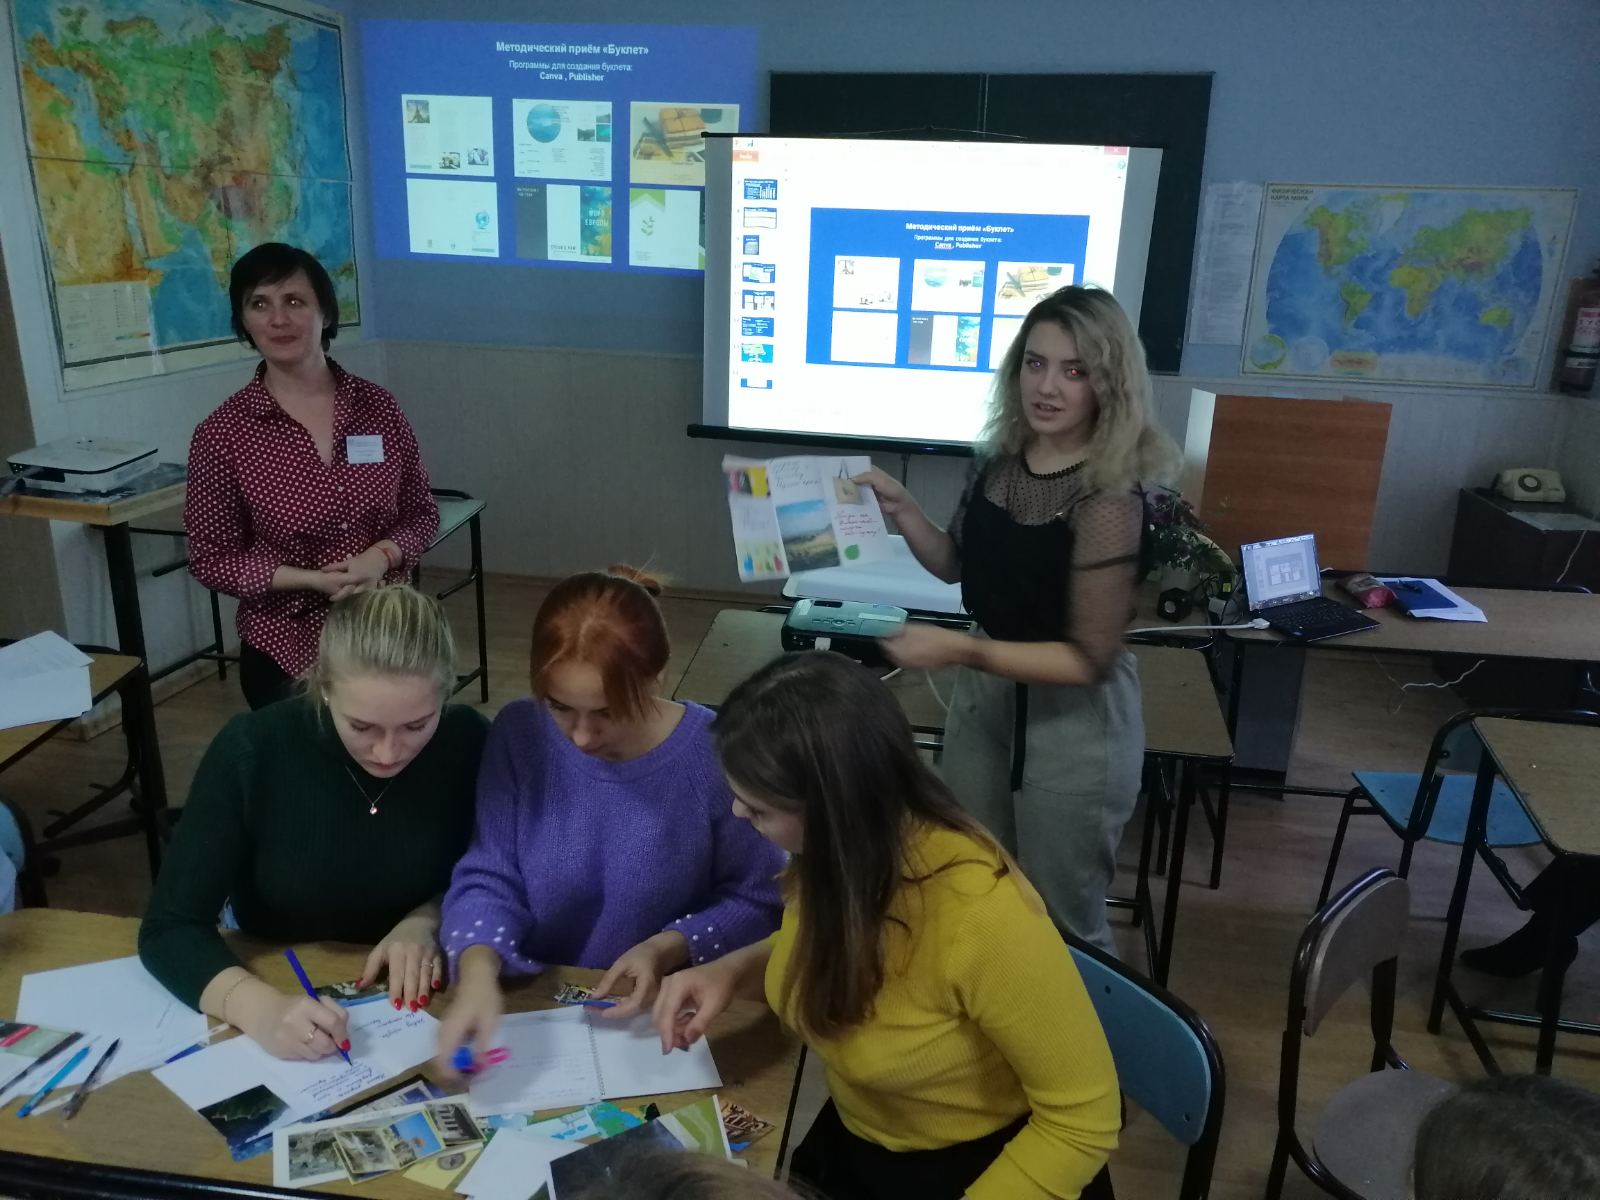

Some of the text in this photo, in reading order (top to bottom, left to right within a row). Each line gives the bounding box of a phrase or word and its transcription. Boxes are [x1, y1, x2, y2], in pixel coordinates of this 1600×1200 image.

[496, 41, 649, 56] Методический приём «Буклет»
[509, 60, 550, 70] Программы
[566, 63, 600, 71] создания
[539, 71, 563, 80] Canva
[568, 72, 605, 81] Publisher
[906, 223, 957, 231] Методический
